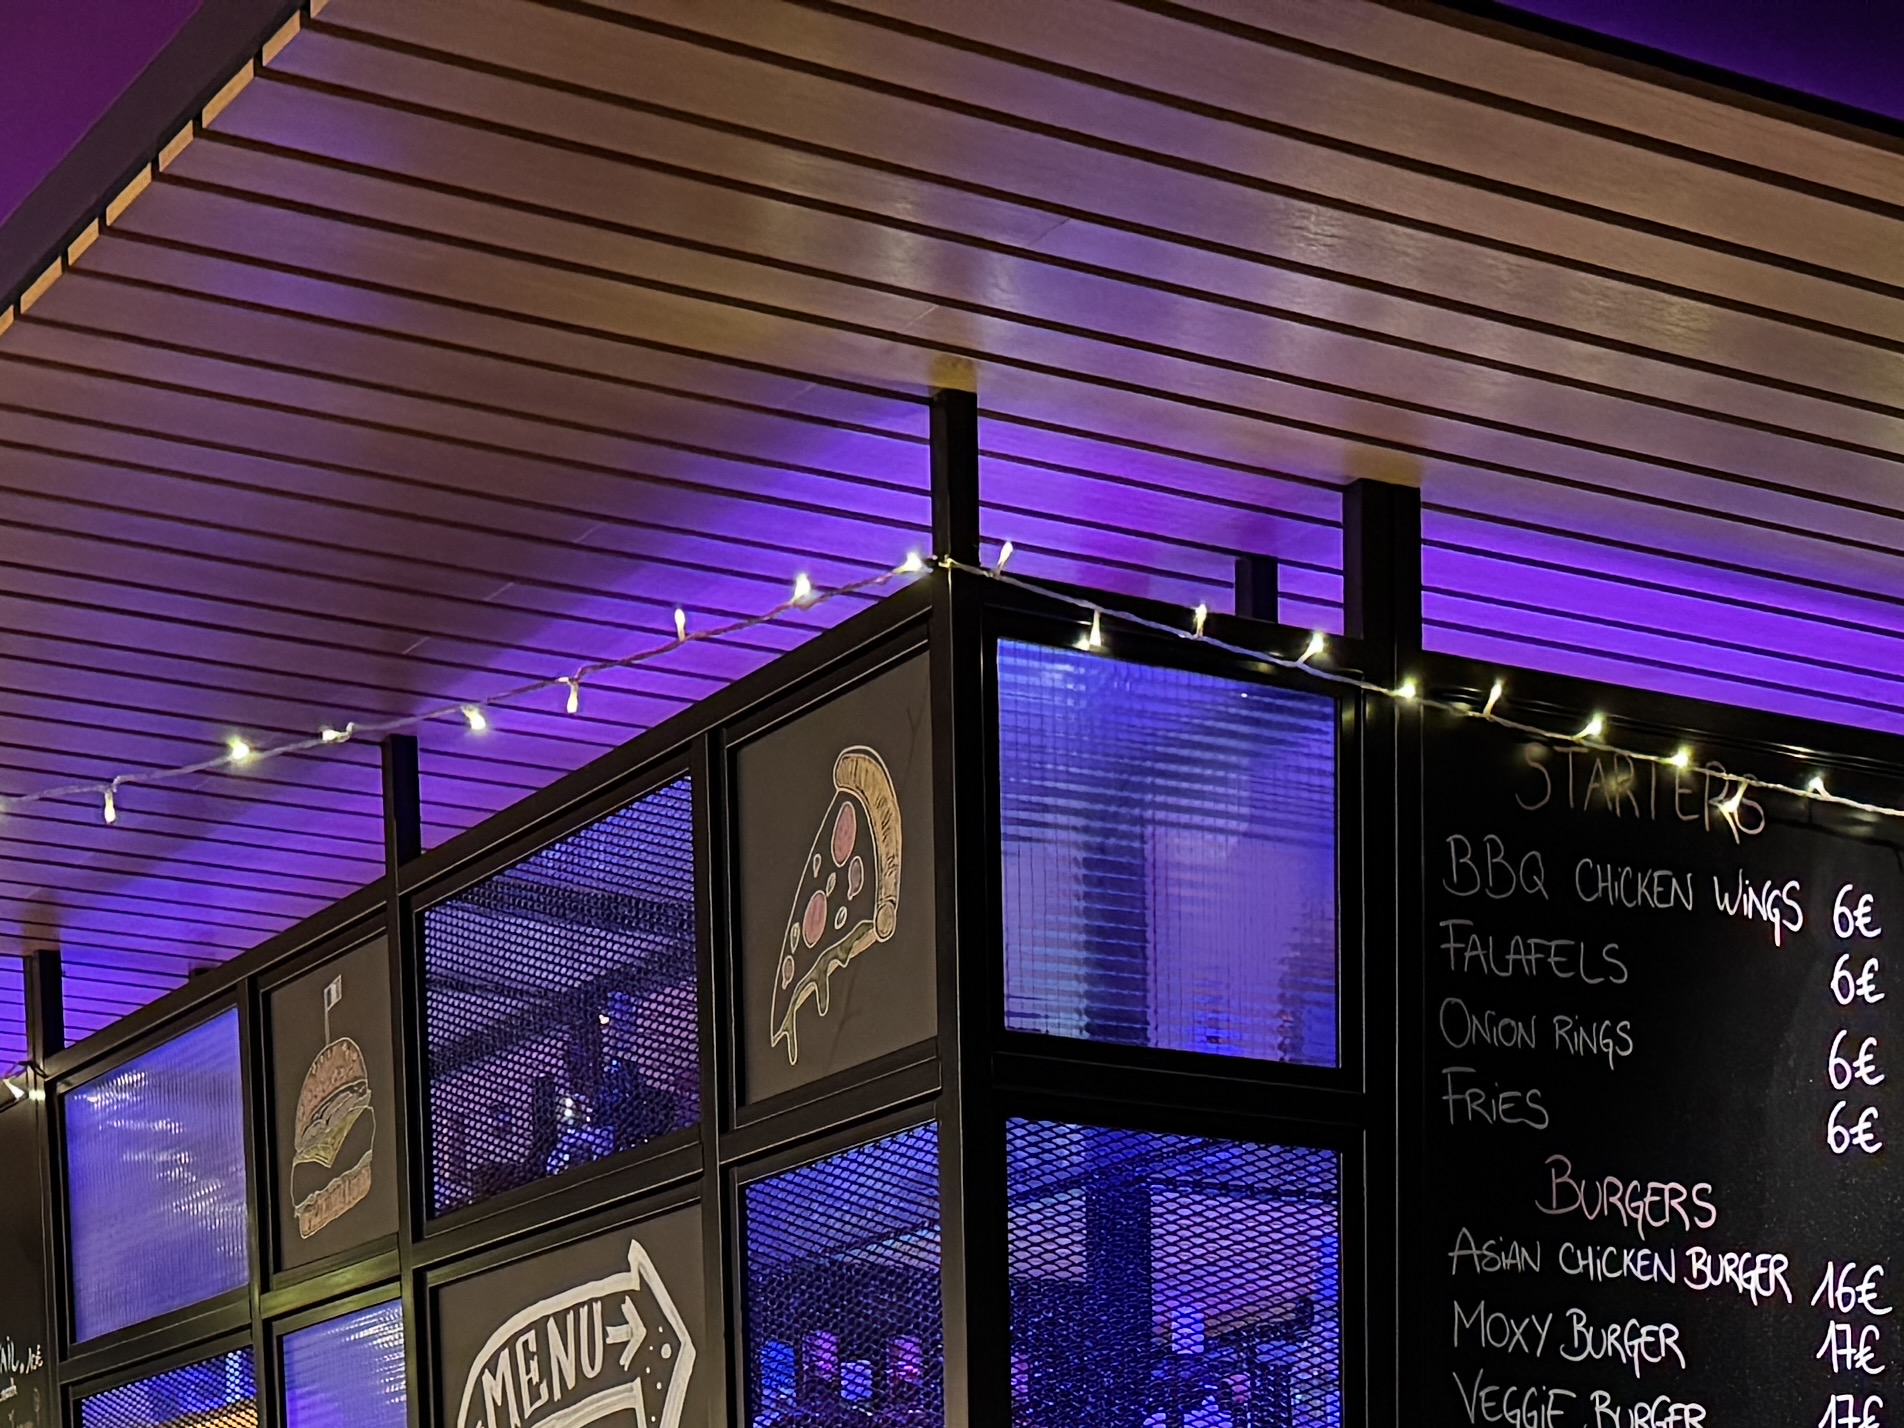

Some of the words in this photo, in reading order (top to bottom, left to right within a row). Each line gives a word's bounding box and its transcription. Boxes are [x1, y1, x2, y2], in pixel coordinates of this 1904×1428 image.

[1515, 743, 1765, 843] STARTERS
[1442, 833, 1549, 899] BBQ
[1575, 857, 1693, 911] CHICKEN
[1832, 885, 1881, 940] 6€
[1439, 918, 1629, 985] FALAFELS
[1831, 954, 1885, 1005] 6€
[1438, 997, 1536, 1051] ONION
[1828, 1031, 1885, 1090] 6€
[1441, 1067, 1550, 1131] FRIES
[1826, 1102, 1883, 1154] 6€
[1535, 1156, 1718, 1232] BURGERS
[1686, 1247, 1793, 1304] BURGER
[1811, 1261, 1893, 1318] 16€
[1453, 1301, 1553, 1352] MOXY
[1560, 1309, 1686, 1378] BURGER
[1816, 1321, 1885, 1375] 17€
